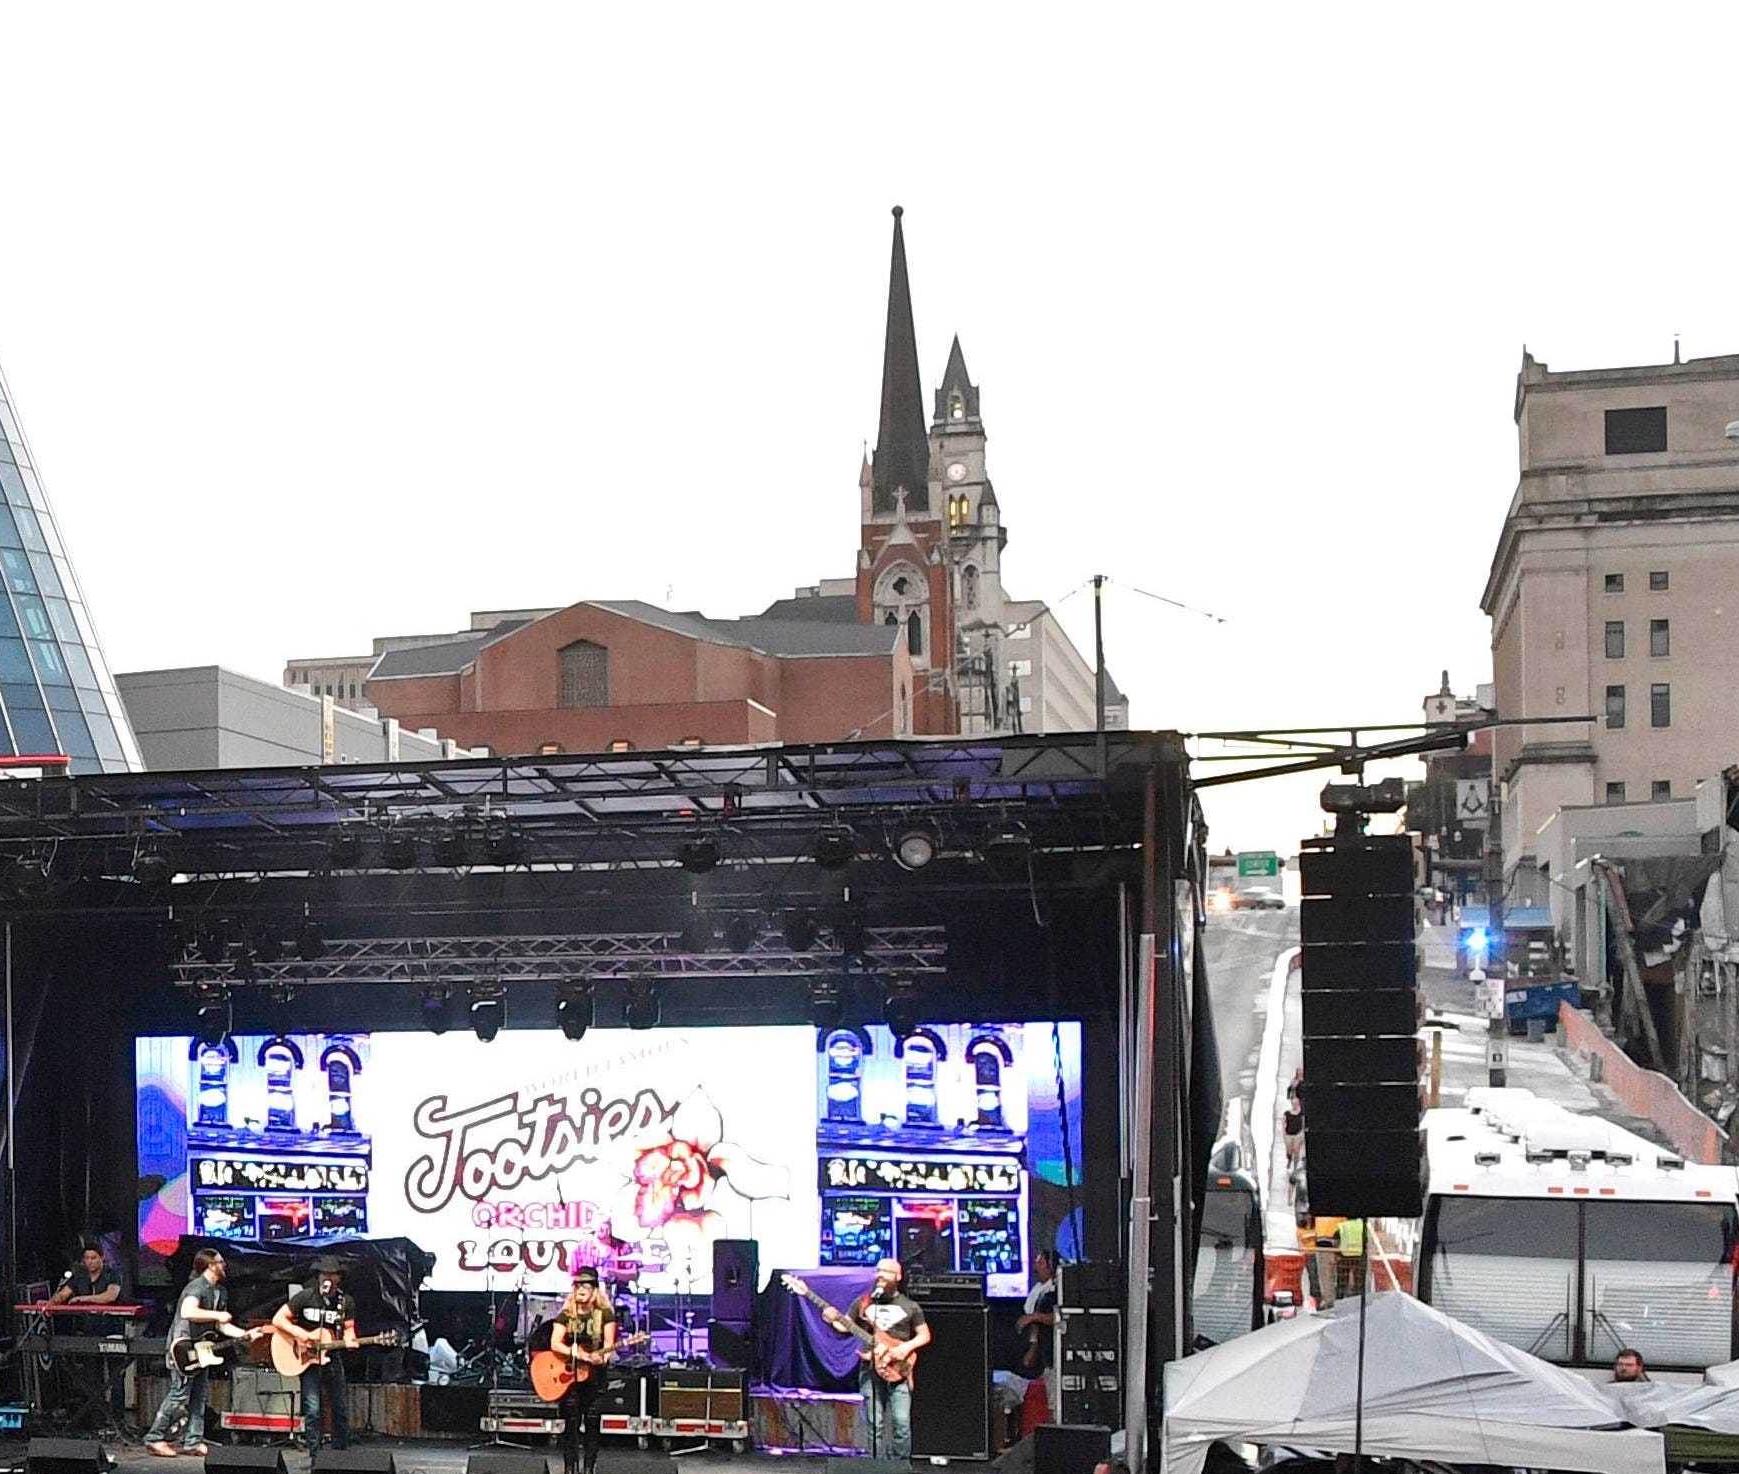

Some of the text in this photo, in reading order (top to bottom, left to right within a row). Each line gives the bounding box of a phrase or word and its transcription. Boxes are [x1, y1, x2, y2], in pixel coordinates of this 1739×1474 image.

[404, 1087, 681, 1214] Tootsies
[472, 1199, 601, 1230] ORCHID
[456, 1238, 672, 1273] LOUE
